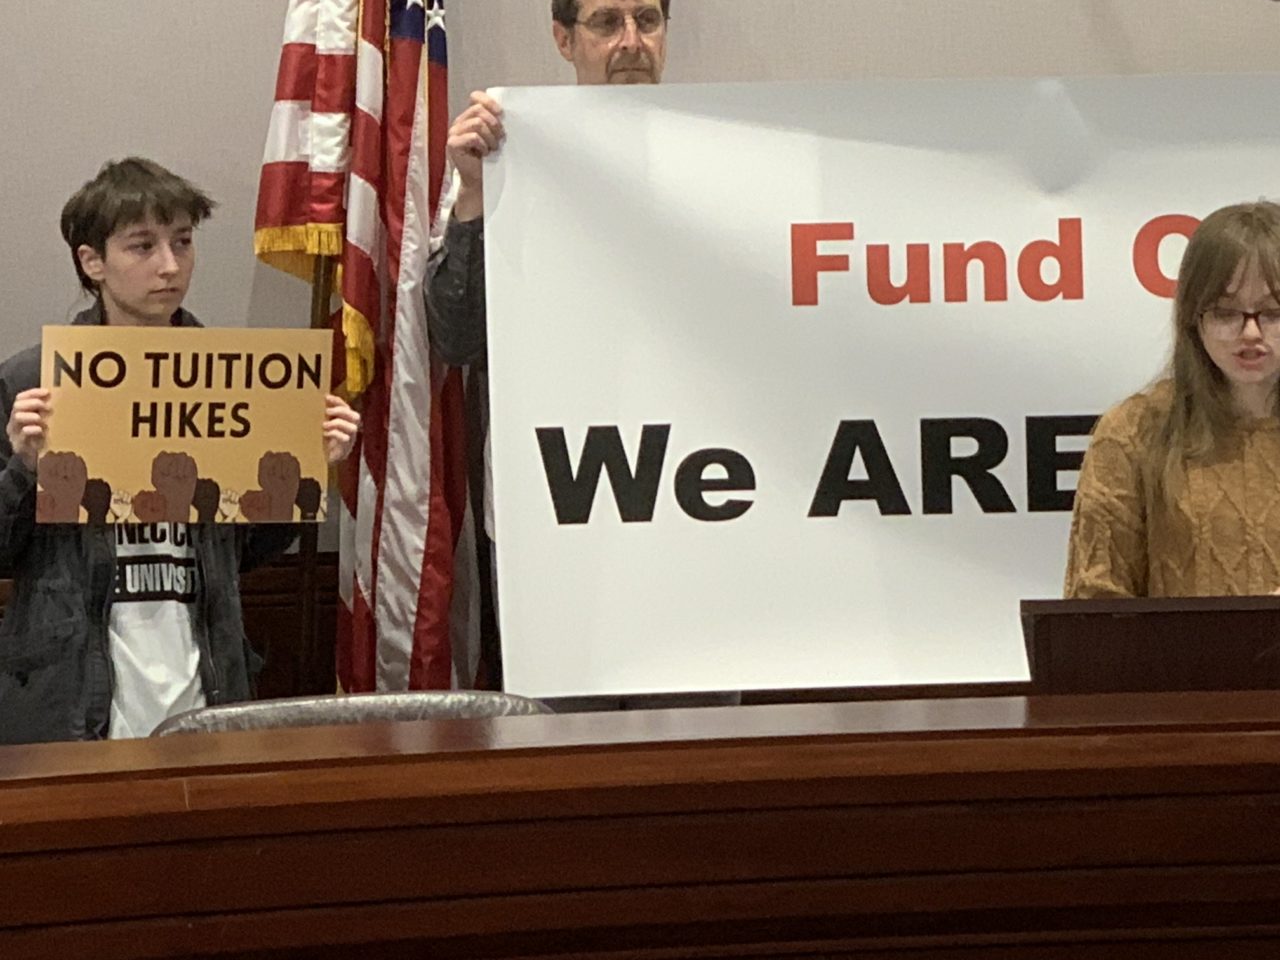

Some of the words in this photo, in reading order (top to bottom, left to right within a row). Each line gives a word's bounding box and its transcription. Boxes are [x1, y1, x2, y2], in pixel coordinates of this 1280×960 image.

[791, 218, 1085, 306] Fund
[53, 350, 127, 389] NO
[144, 352, 322, 390] TUITION
[131, 401, 251, 439] HIKES
[535, 423, 757, 525] We
[807, 414, 1103, 518] ARE
